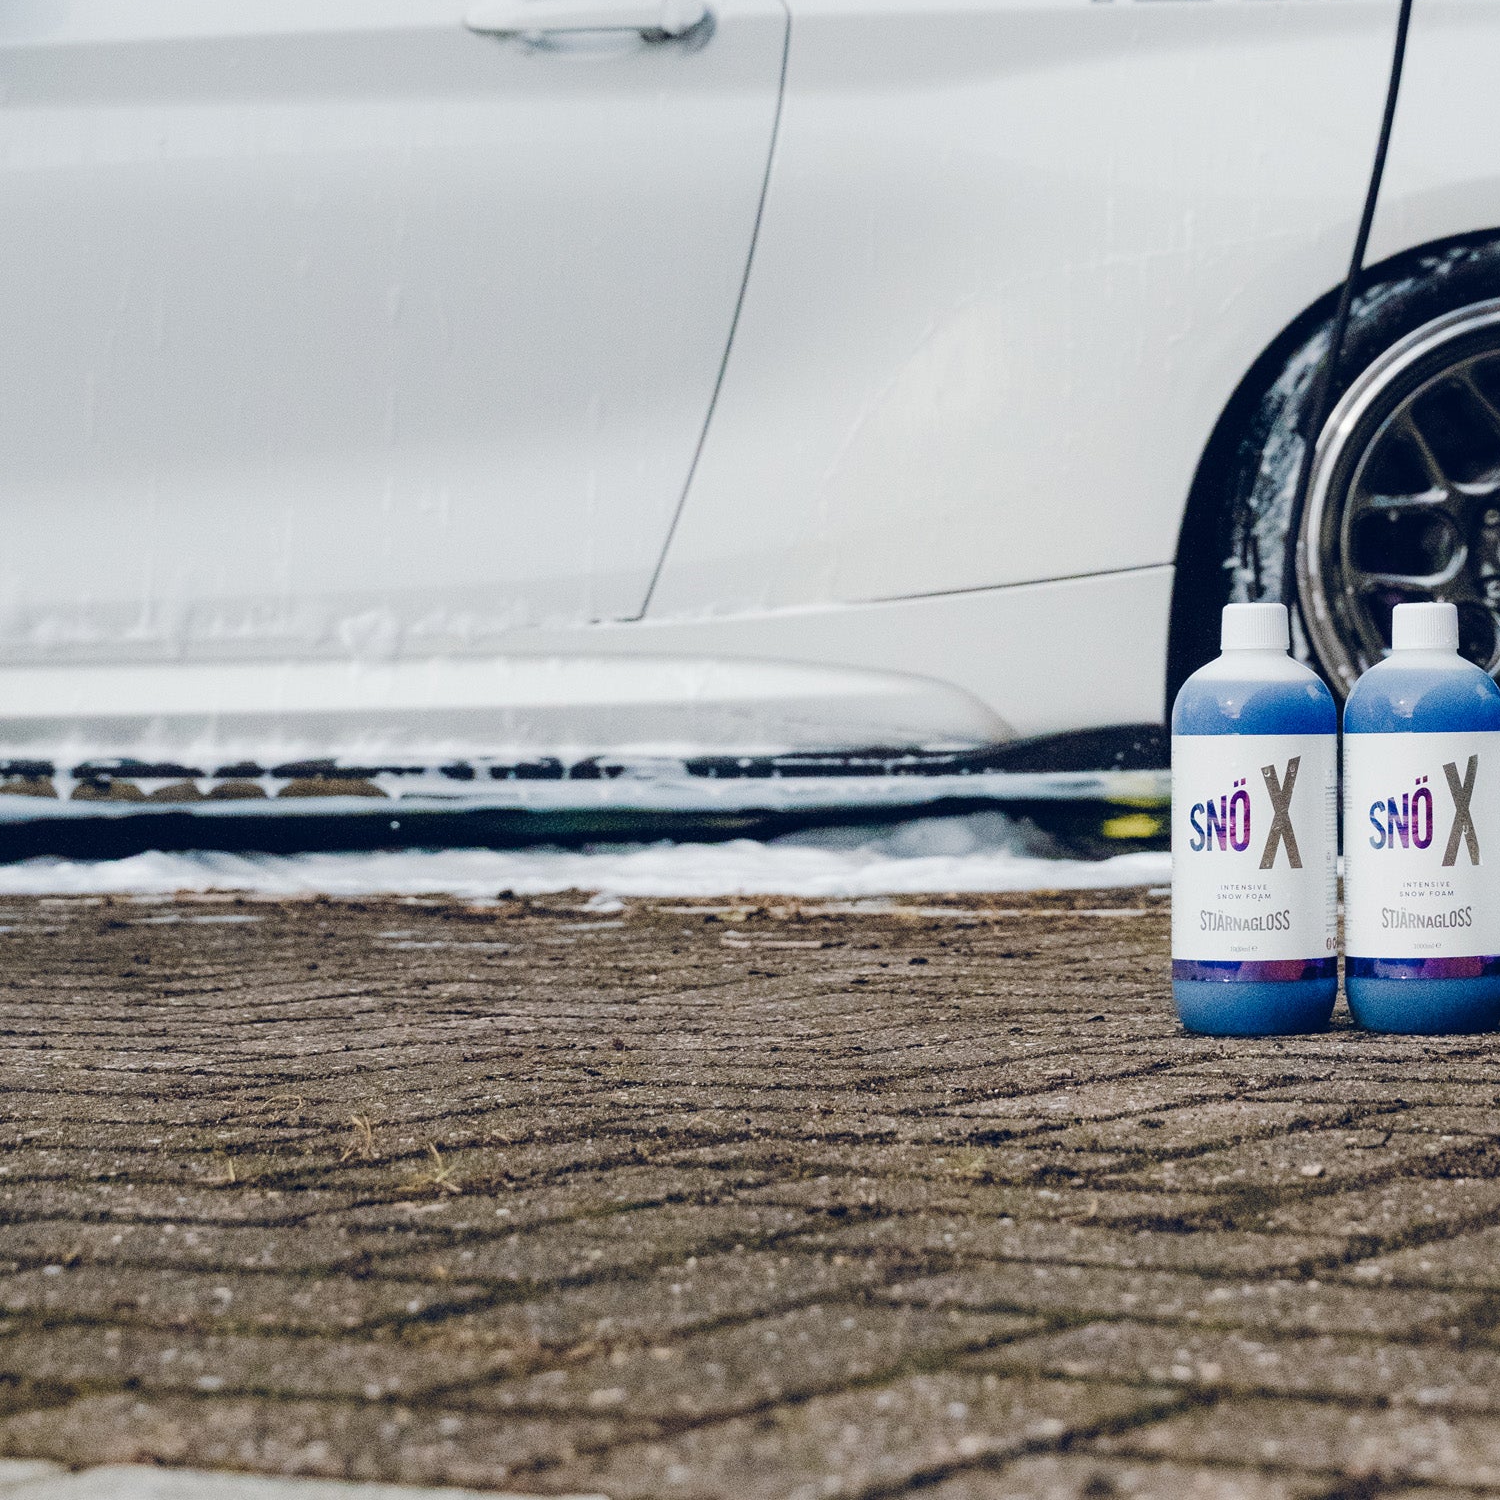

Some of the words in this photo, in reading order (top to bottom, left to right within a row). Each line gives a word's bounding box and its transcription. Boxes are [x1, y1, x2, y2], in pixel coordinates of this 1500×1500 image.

[1189, 778, 1251, 852] SNÖ
[1259, 755, 1303, 870] X
[1369, 775, 1433, 850] SNÖ
[1442, 754, 1481, 867] X
[1200, 909, 1290, 931] STJÄRNAGLOSS
[1381, 906, 1472, 929] STJÄRNAGLOSS
